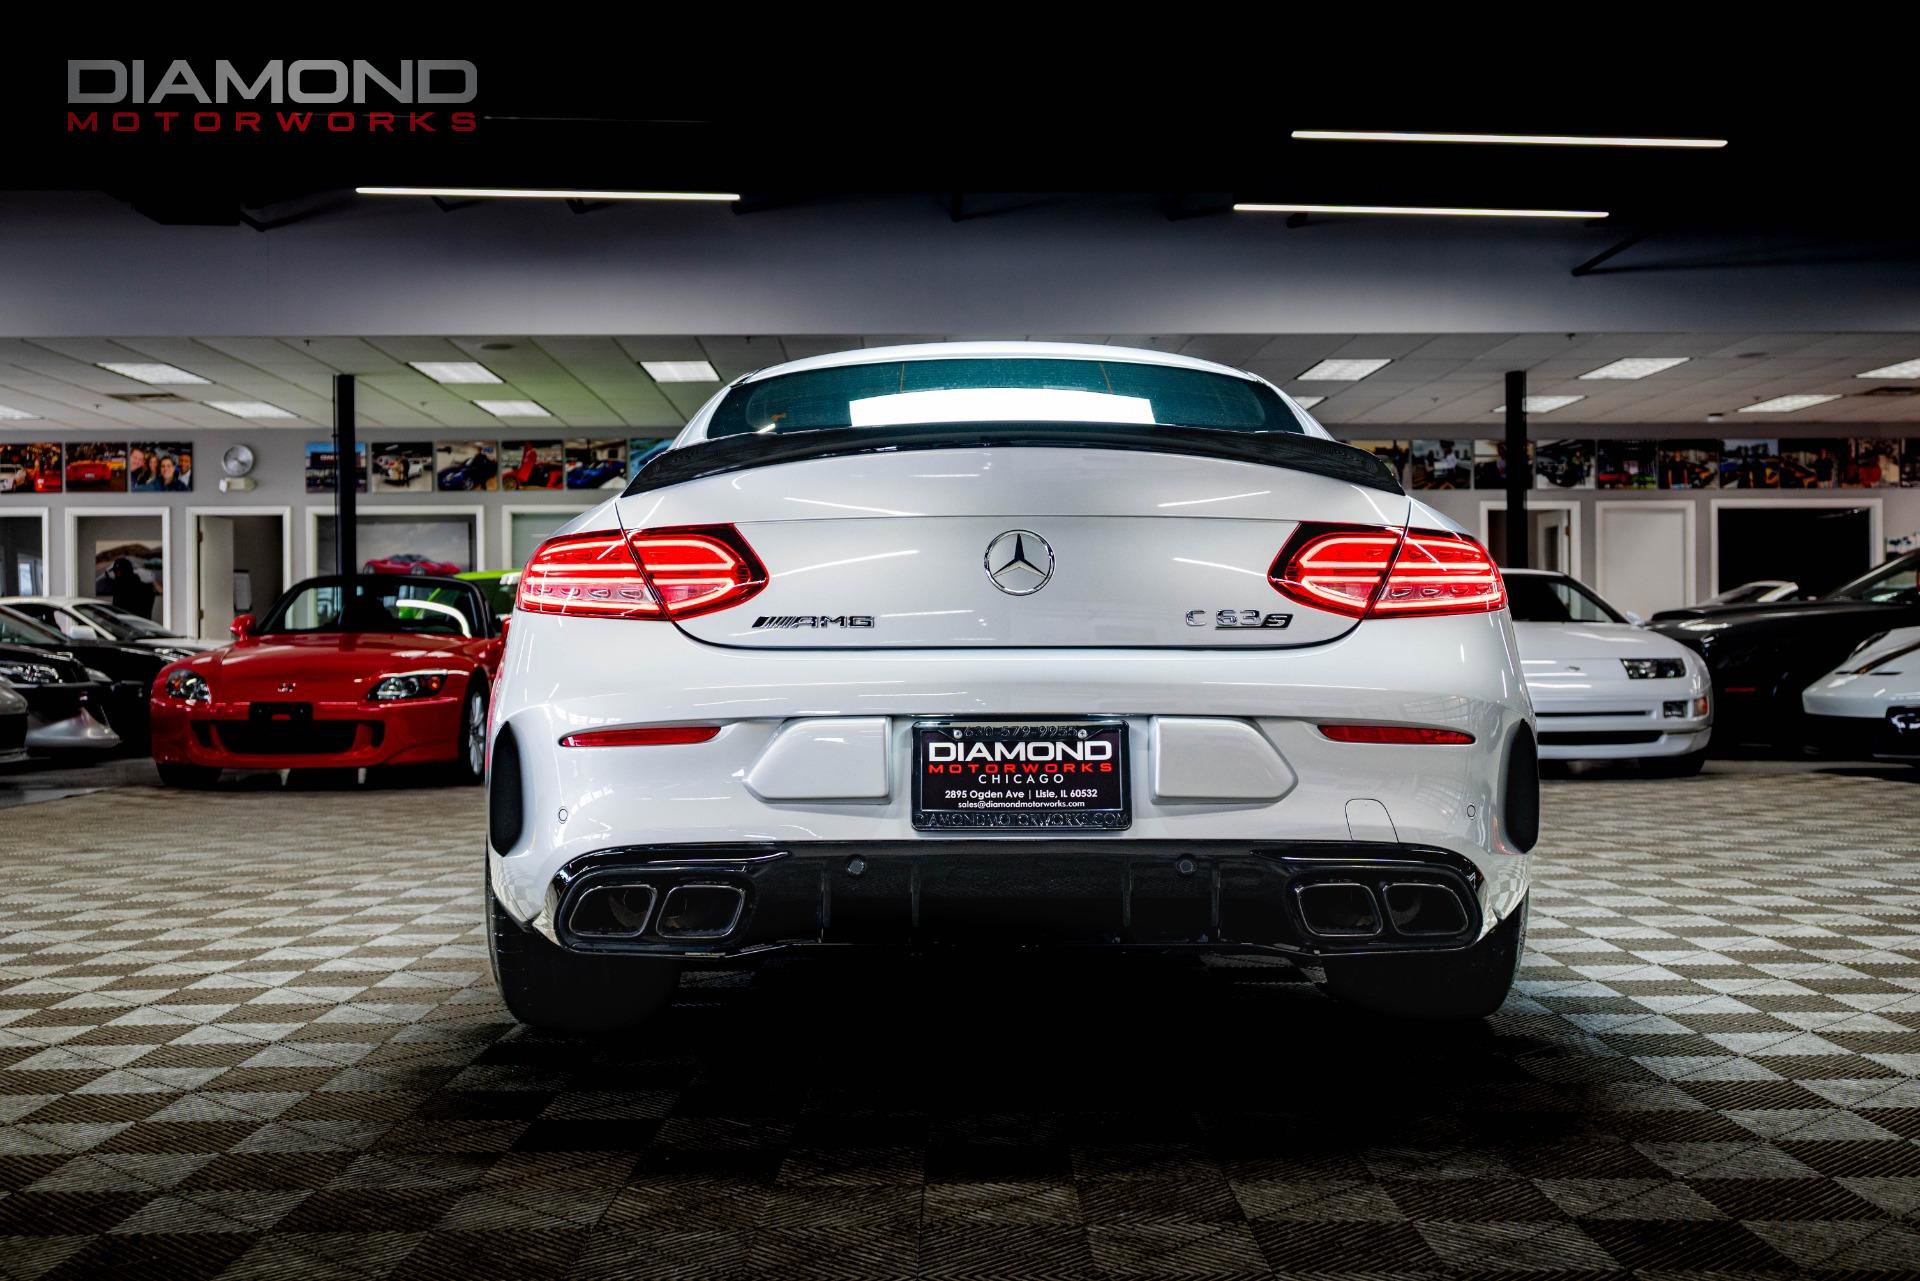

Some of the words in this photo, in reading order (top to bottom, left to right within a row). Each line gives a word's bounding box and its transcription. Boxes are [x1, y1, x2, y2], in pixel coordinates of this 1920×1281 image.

[1185, 609, 1207, 627] C
[928, 740, 1113, 762] DIAMOND
[928, 763, 1112, 774] MOTORWORKS
[978, 774, 1064, 784] CHICAGO
[944, 790, 968, 799] 2895
[969, 790, 1004, 800] Ogden
[1005, 790, 1025, 798] Ave
[1060, 789, 1068, 798] IL
[1070, 789, 1098, 798] 60532
[957, 800, 1086, 809] sales@diamondmotorworks.com
